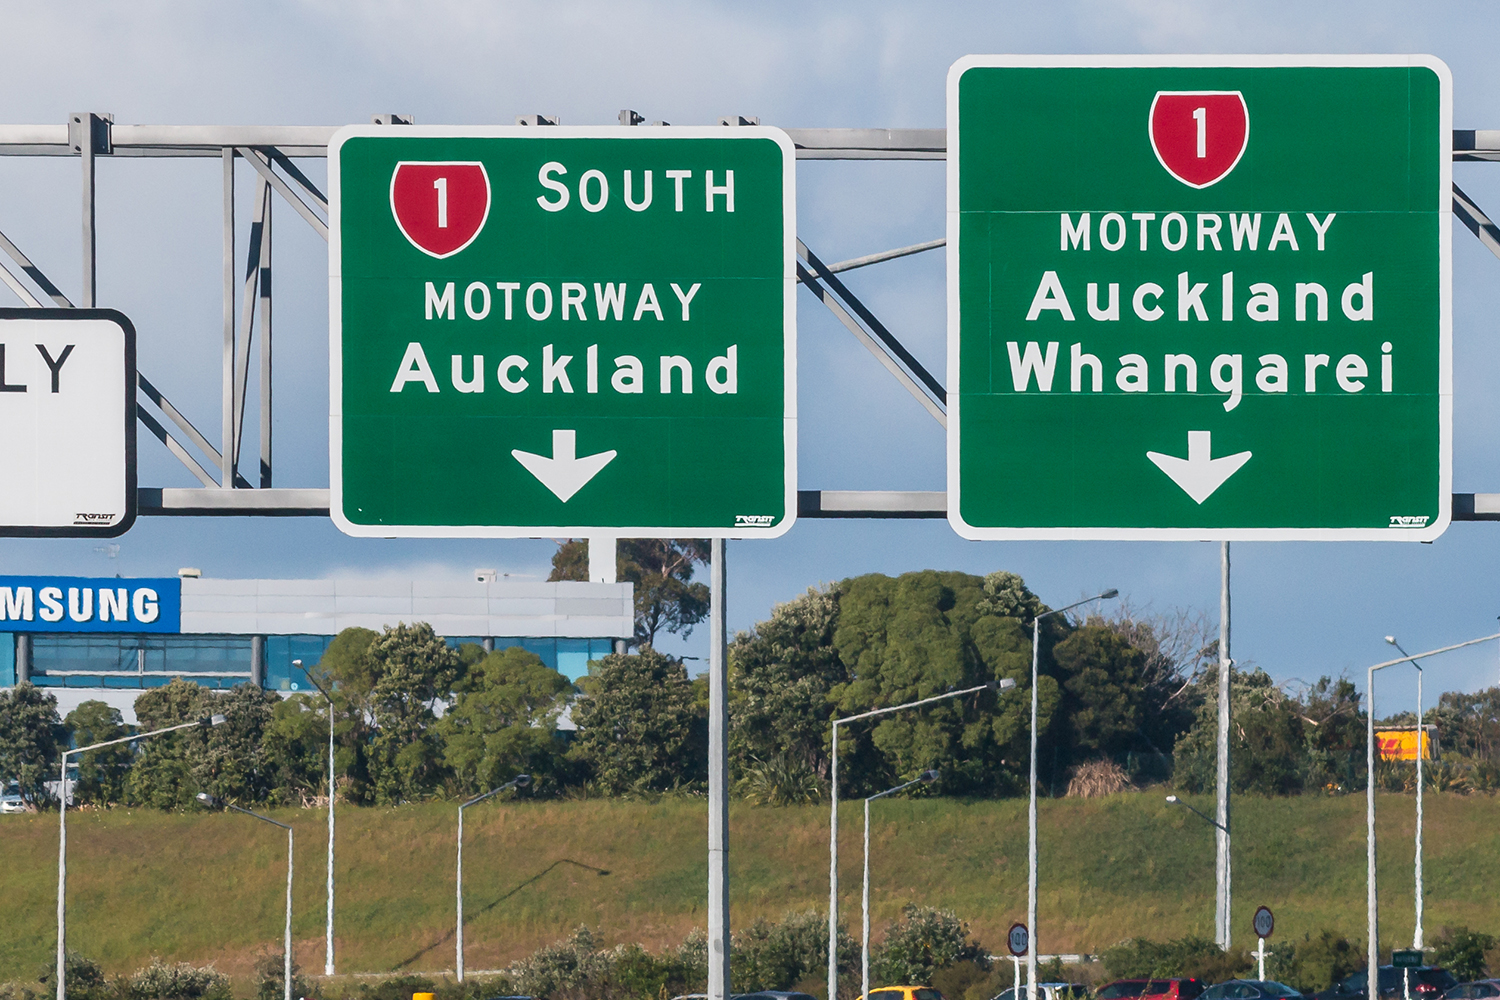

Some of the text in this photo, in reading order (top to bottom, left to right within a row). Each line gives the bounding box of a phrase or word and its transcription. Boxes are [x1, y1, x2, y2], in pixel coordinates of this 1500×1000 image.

[1192, 108, 1206, 158] 1
[434, 161, 735, 227] 1 SOUTH
[1060, 213, 1337, 252] MOTORWAY
[425, 282, 702, 321] MOTORWAY
[1025, 271, 1374, 322] Auckland
[390, 342, 738, 394] Auckland
[1006, 342, 1393, 412] Whangarei
[0, 587, 159, 623] MSUNG
